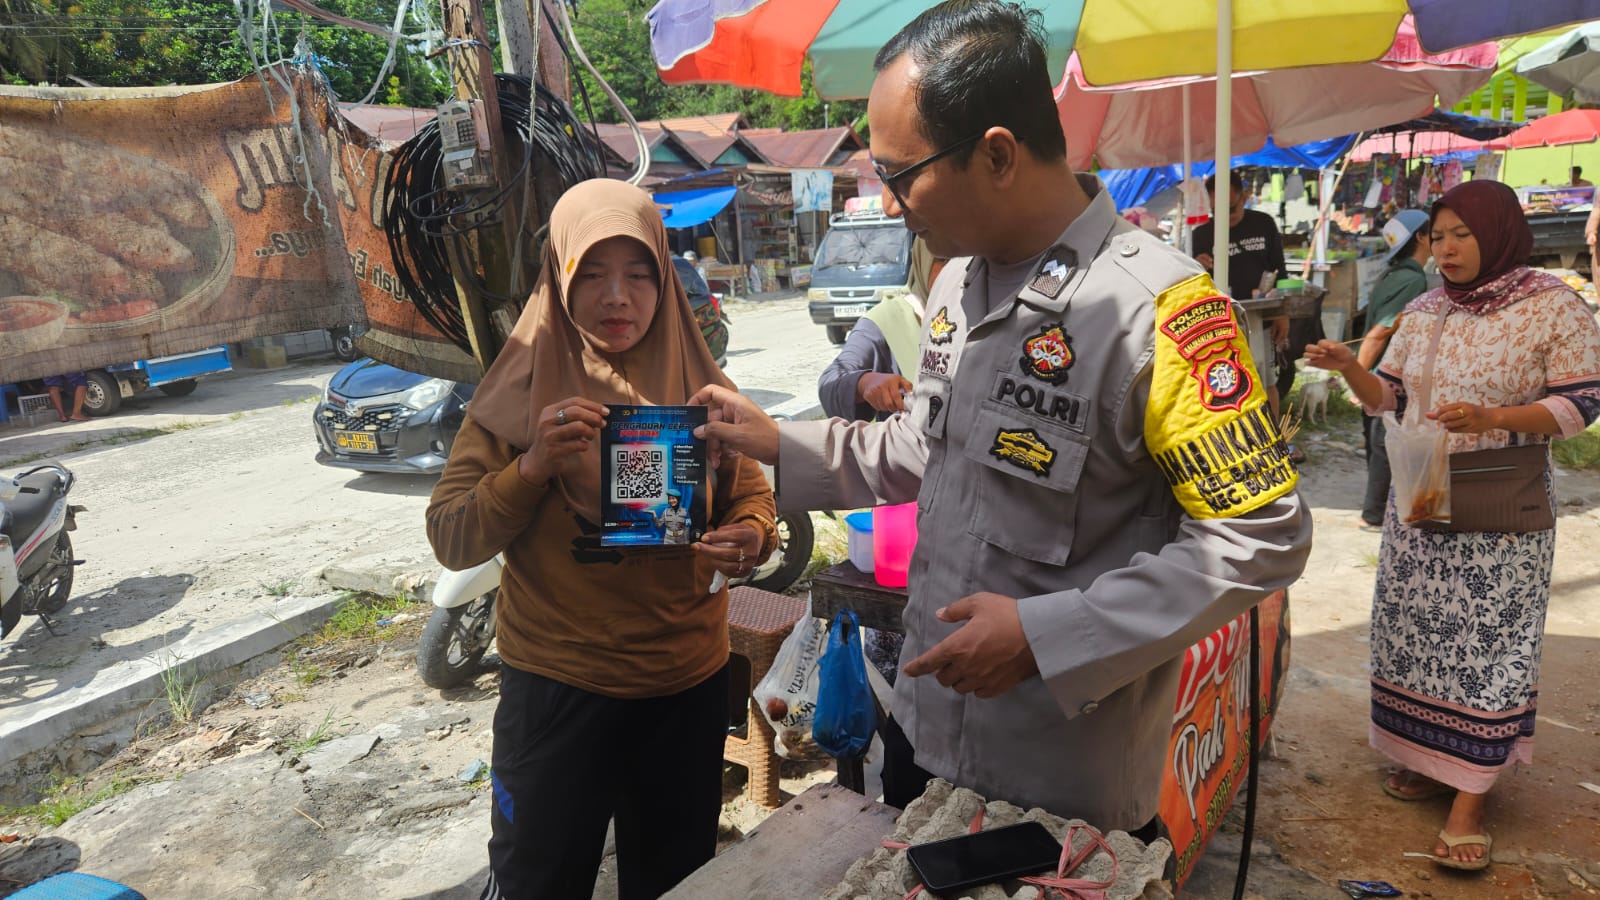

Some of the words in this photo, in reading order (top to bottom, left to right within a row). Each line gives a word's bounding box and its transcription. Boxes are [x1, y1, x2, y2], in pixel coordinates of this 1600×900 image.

[1167, 301, 1225, 332] POLRESTA
[997, 379, 1080, 425] POLRI
[1205, 487, 1249, 513] KEC.
[1174, 697, 1226, 820] Pak
